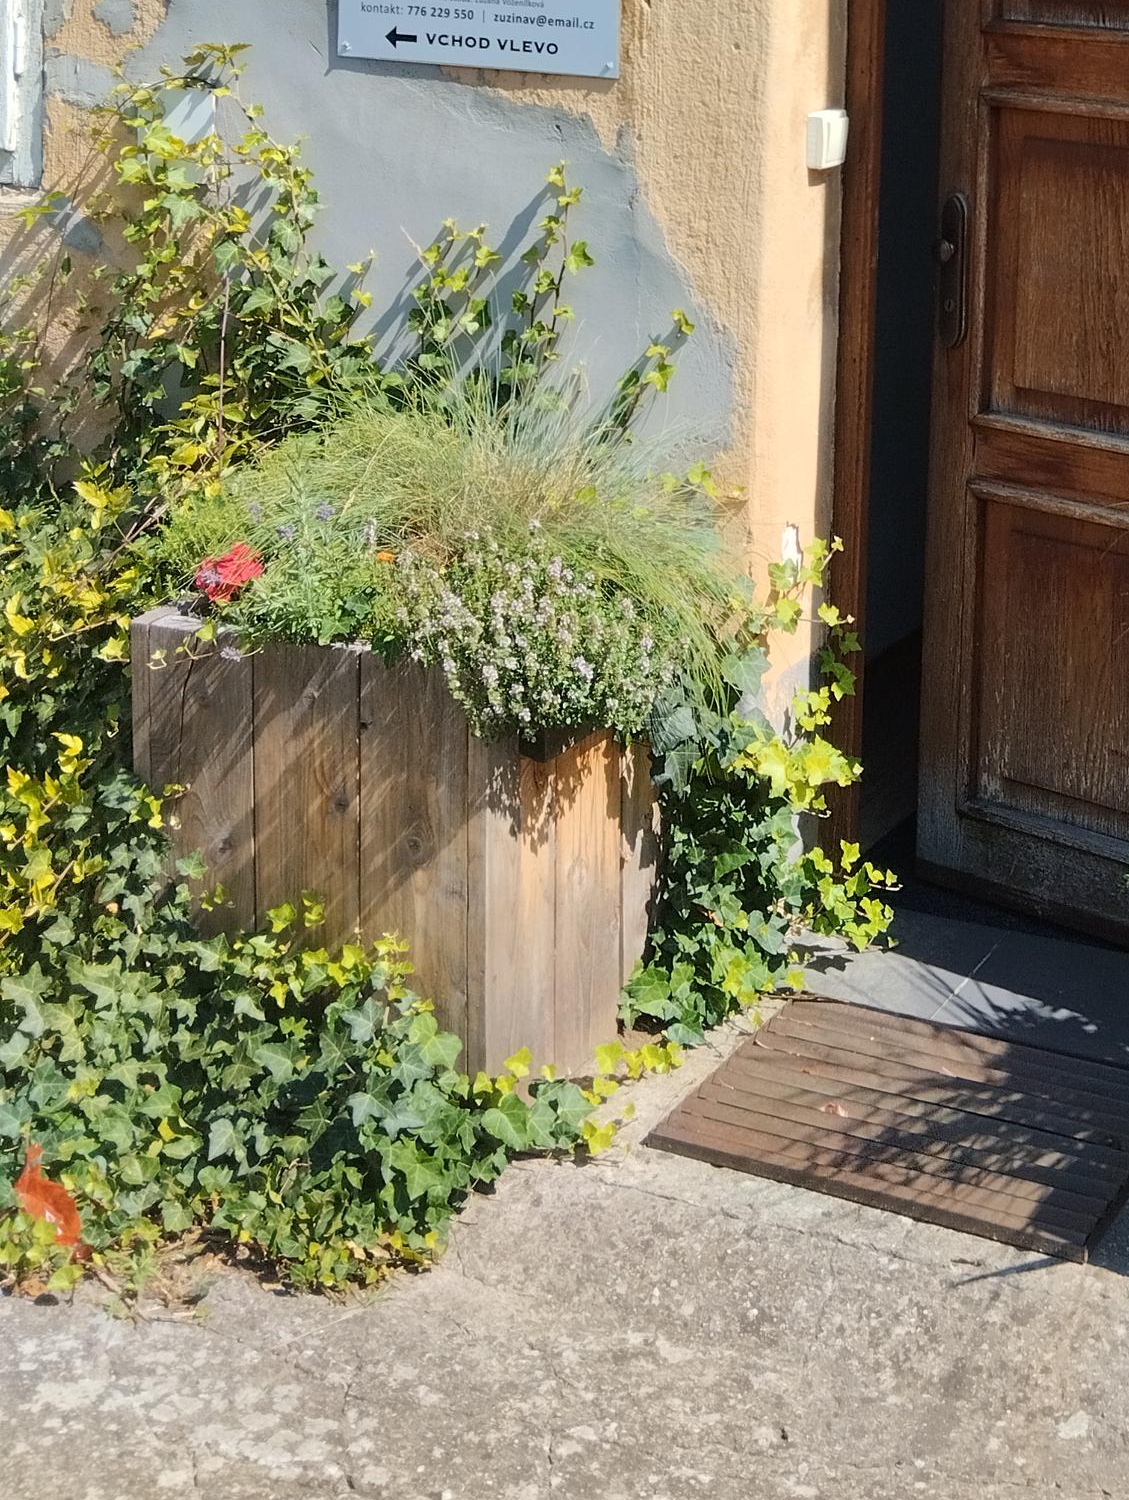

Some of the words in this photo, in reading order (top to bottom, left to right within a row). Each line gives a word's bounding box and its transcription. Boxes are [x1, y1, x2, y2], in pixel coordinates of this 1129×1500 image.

[361, 2, 404, 15] kontakt:
[407, 5, 427, 16] 776
[430, 7, 450, 18] 229
[454, 9, 474, 20] 550
[494, 12, 595, 30] zuzinav@email.cz
[426, 33, 490, 49] VCHOD
[497, 38, 559, 55] VLEVO
